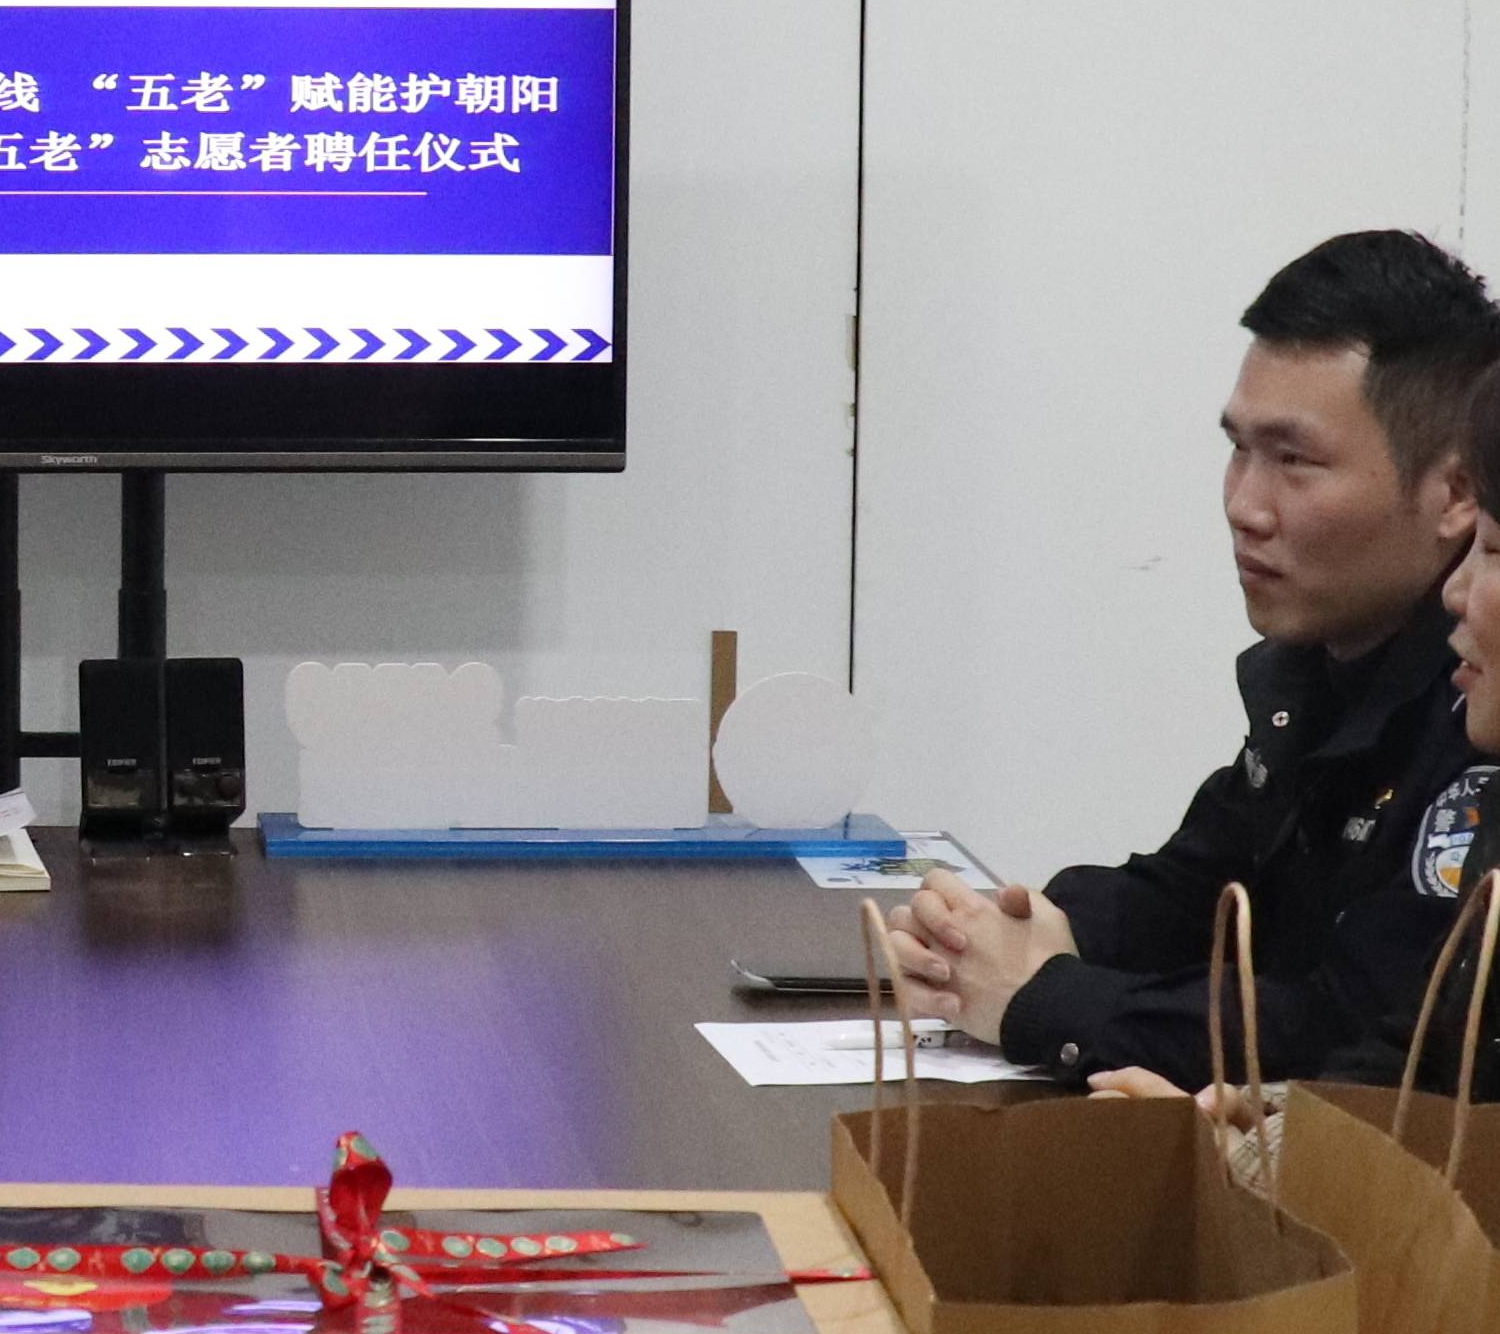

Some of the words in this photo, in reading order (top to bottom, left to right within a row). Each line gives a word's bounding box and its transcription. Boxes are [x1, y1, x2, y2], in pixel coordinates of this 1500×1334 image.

[89, 71, 562, 117] “五老”赋能护朝阳
